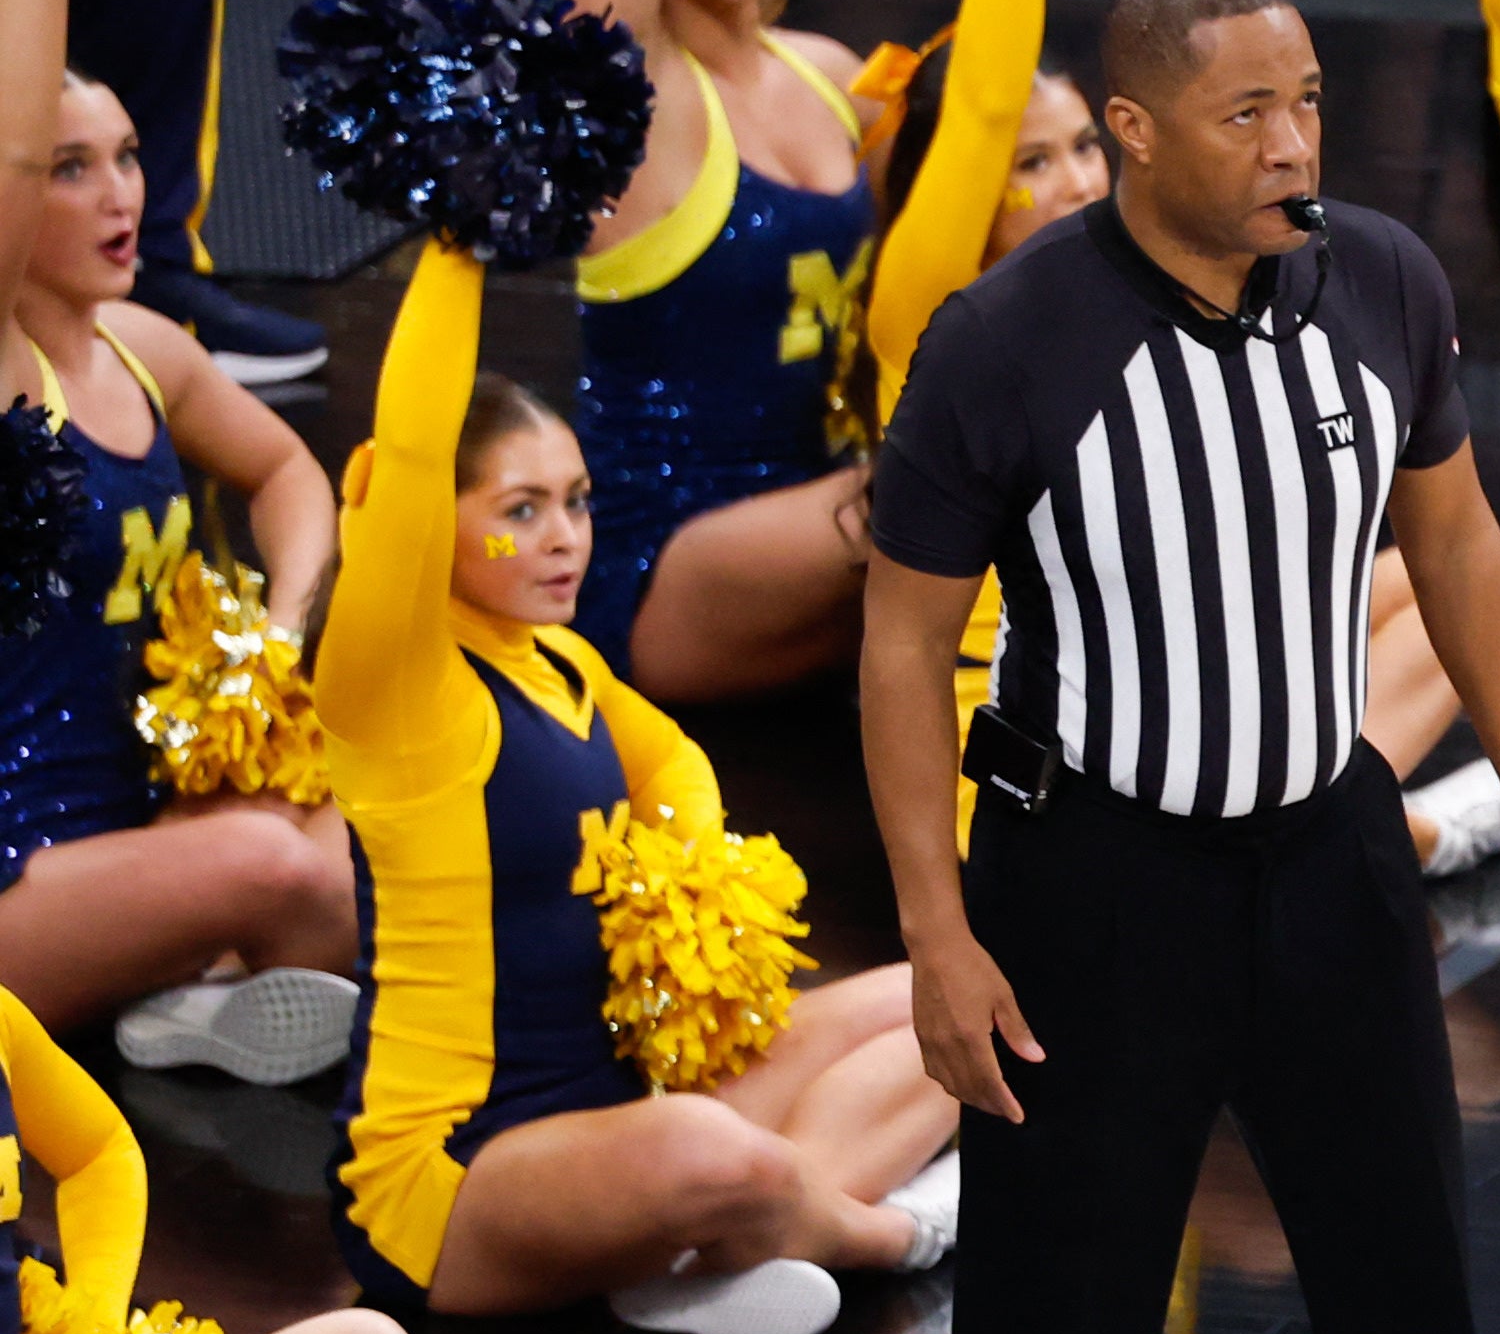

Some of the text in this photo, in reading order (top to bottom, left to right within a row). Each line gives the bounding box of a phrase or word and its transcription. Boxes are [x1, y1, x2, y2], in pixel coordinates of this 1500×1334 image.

[1316, 414, 1355, 448] TW
[104, 495, 191, 625] M
[484, 532, 518, 560] M
